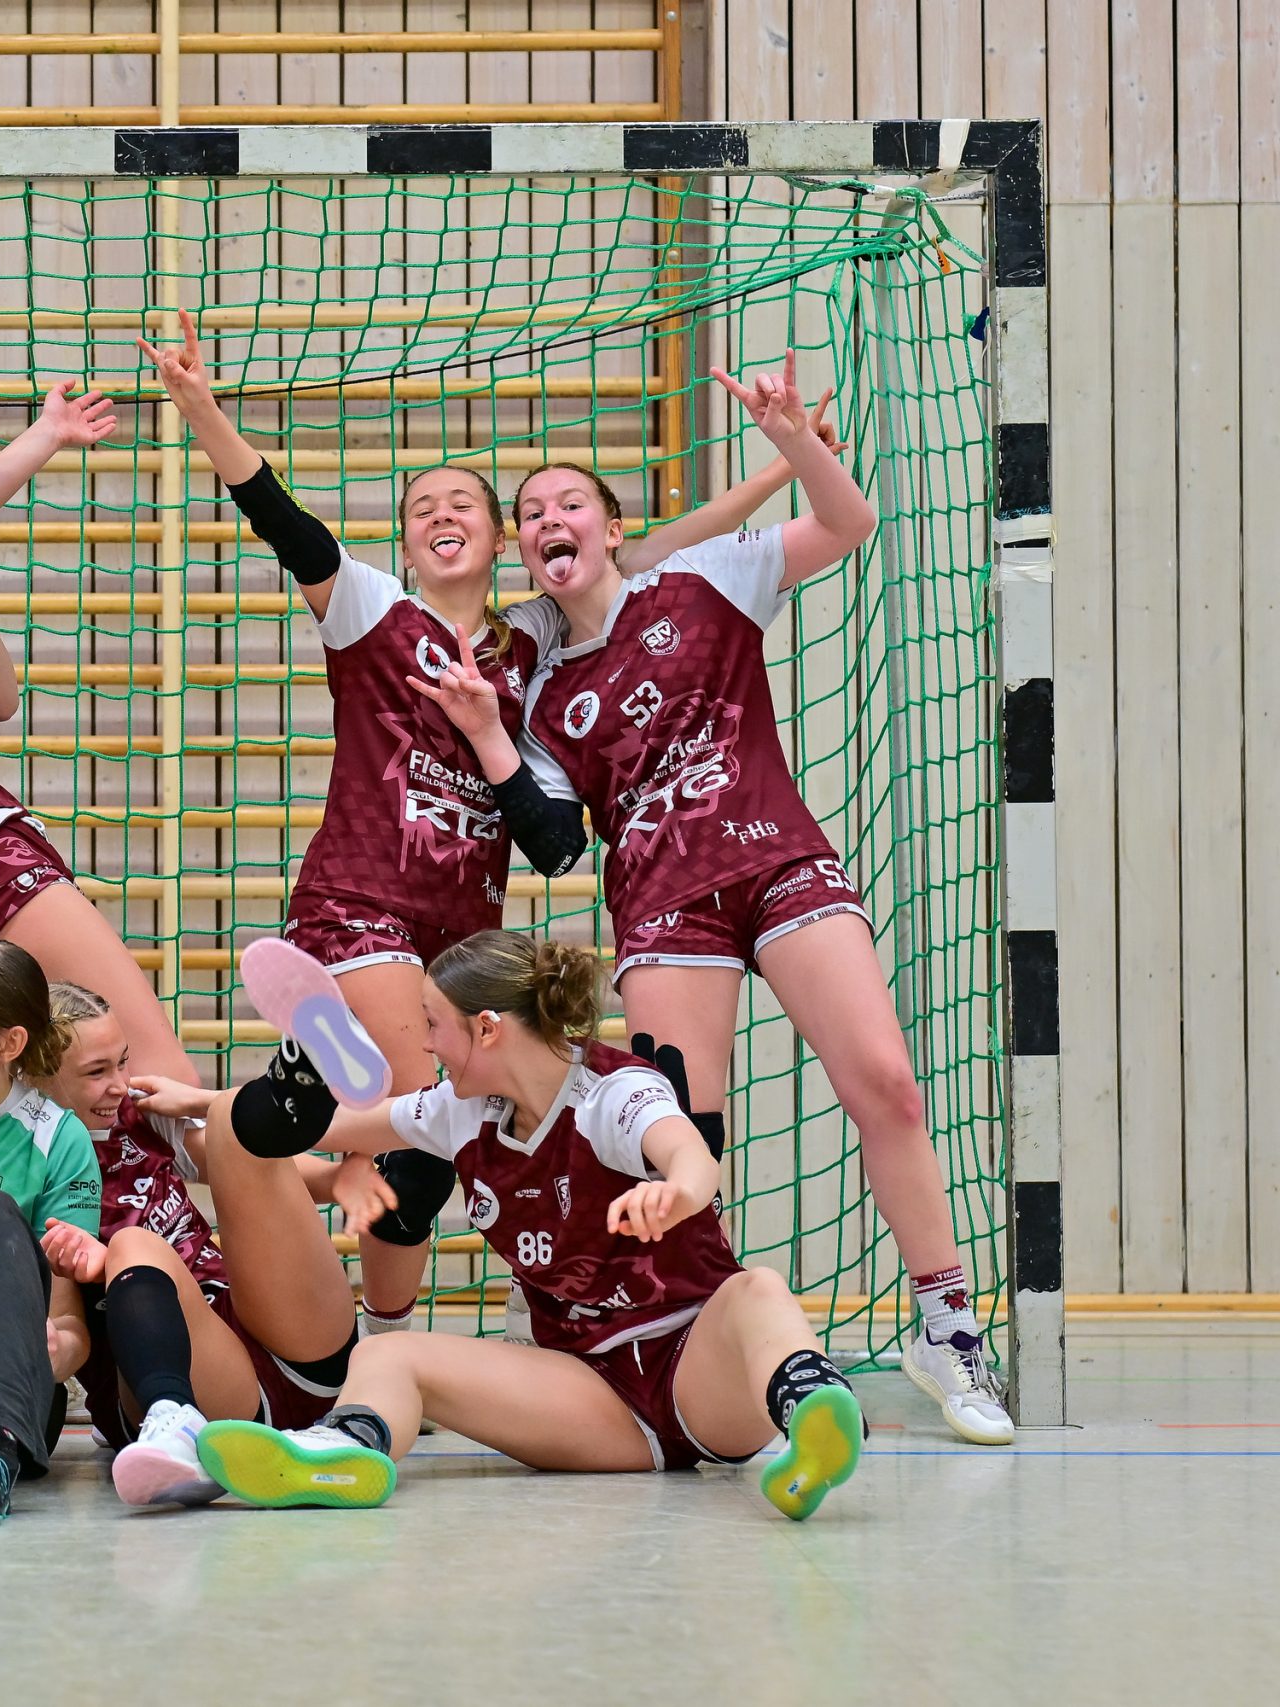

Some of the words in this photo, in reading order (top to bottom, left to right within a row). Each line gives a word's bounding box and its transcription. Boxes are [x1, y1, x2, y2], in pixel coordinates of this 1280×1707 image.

[620, 681, 663, 729] 53
[738, 820, 780, 846] FHB
[516, 1231, 553, 1267] 86
